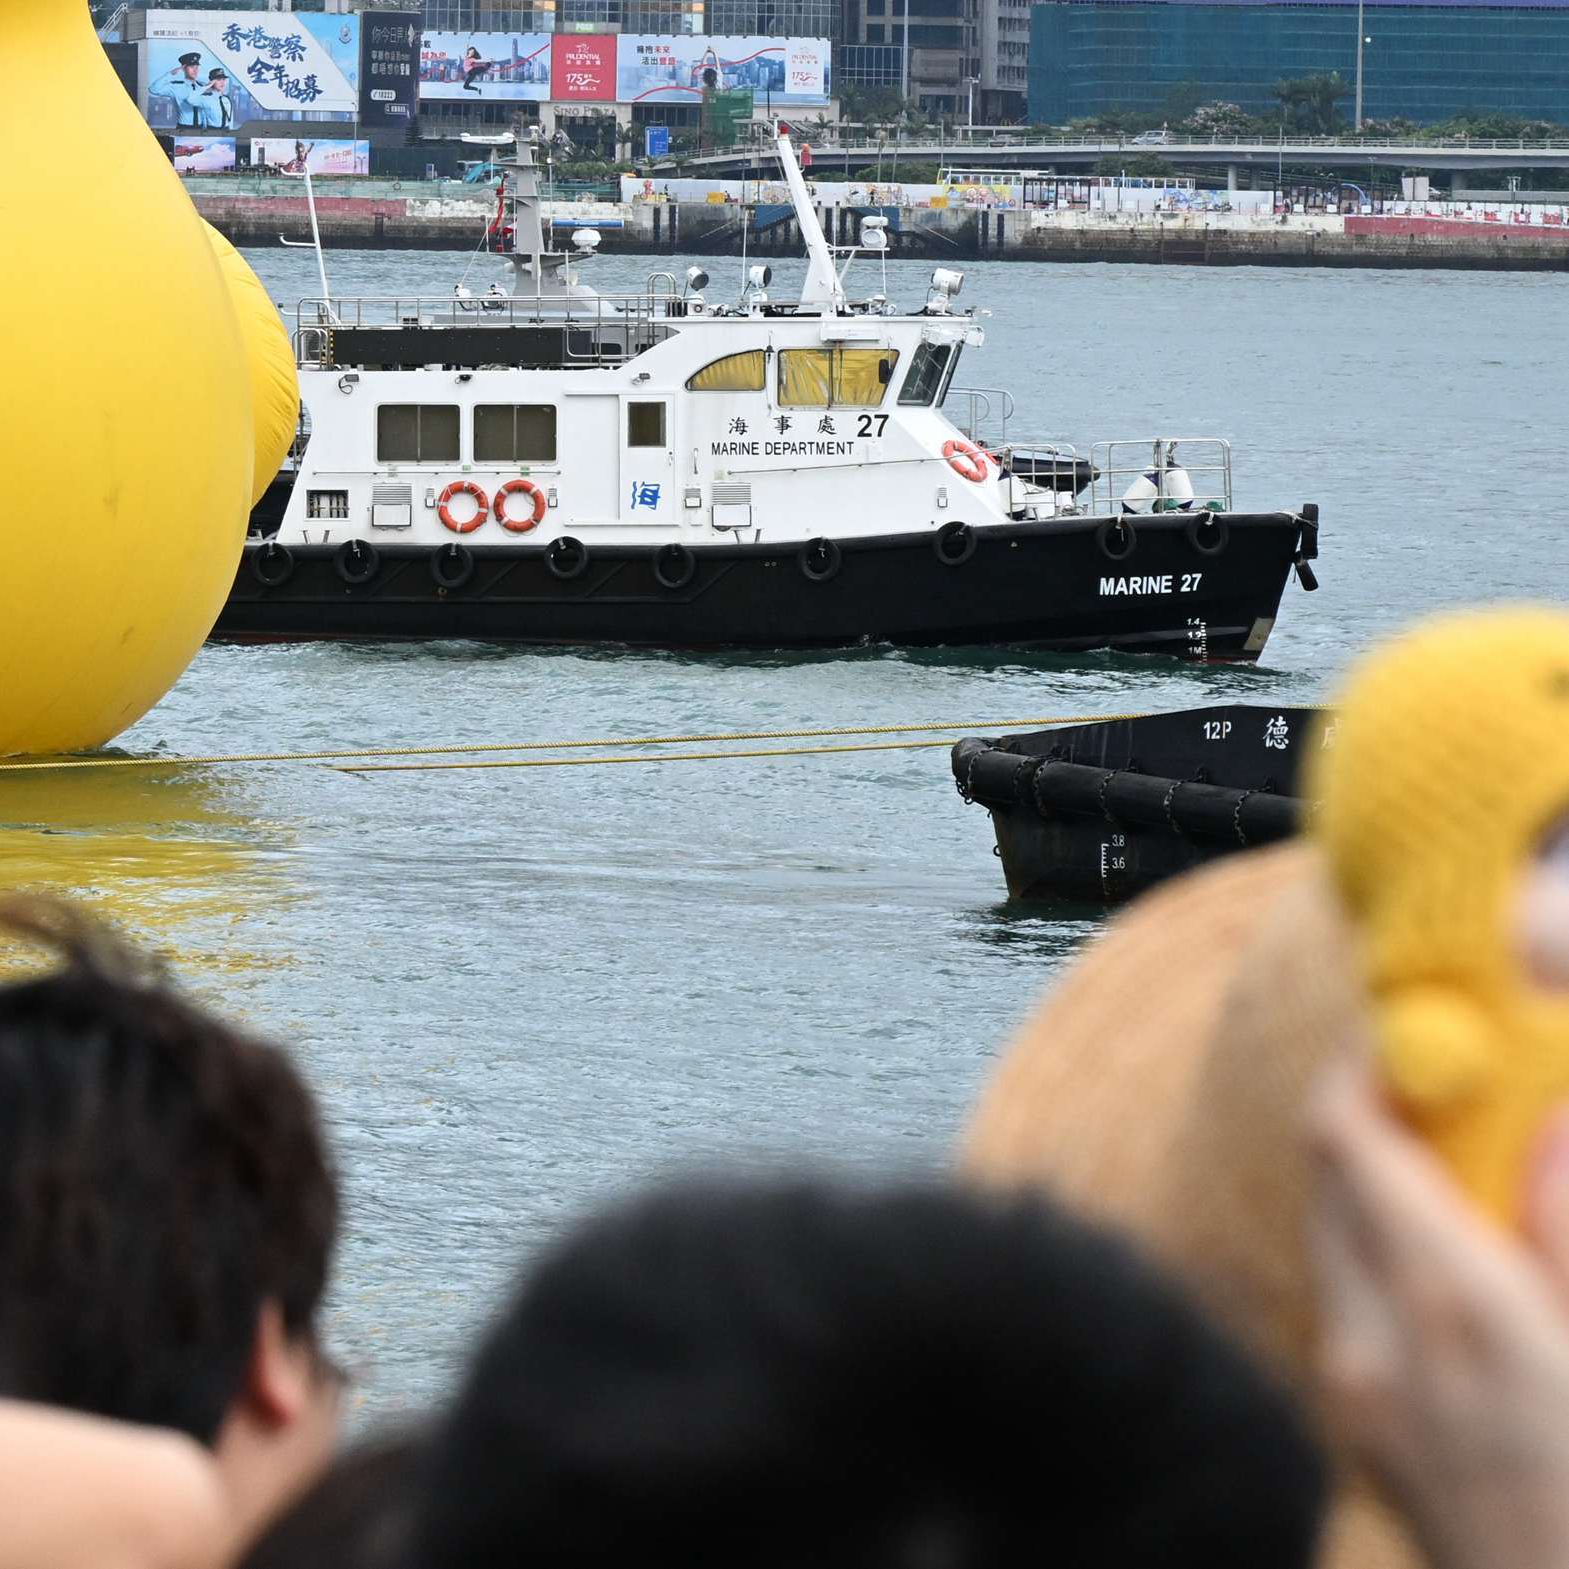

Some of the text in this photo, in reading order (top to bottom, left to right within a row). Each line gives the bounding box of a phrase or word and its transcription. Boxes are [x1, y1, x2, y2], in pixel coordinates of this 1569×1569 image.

[221, 22, 307, 63] 香港警察
[247, 56, 324, 104] 全年招募
[566, 73, 584, 83] 175
[728, 414, 889, 438] 海事處 27
[711, 441, 855, 455] MARINE DEPARTMENT
[1099, 573, 1202, 596] MARINE 27
[1203, 721, 1232, 740] 12P
[1112, 835, 1125, 847] 3.8
[1112, 857, 1125, 869] 3.6
